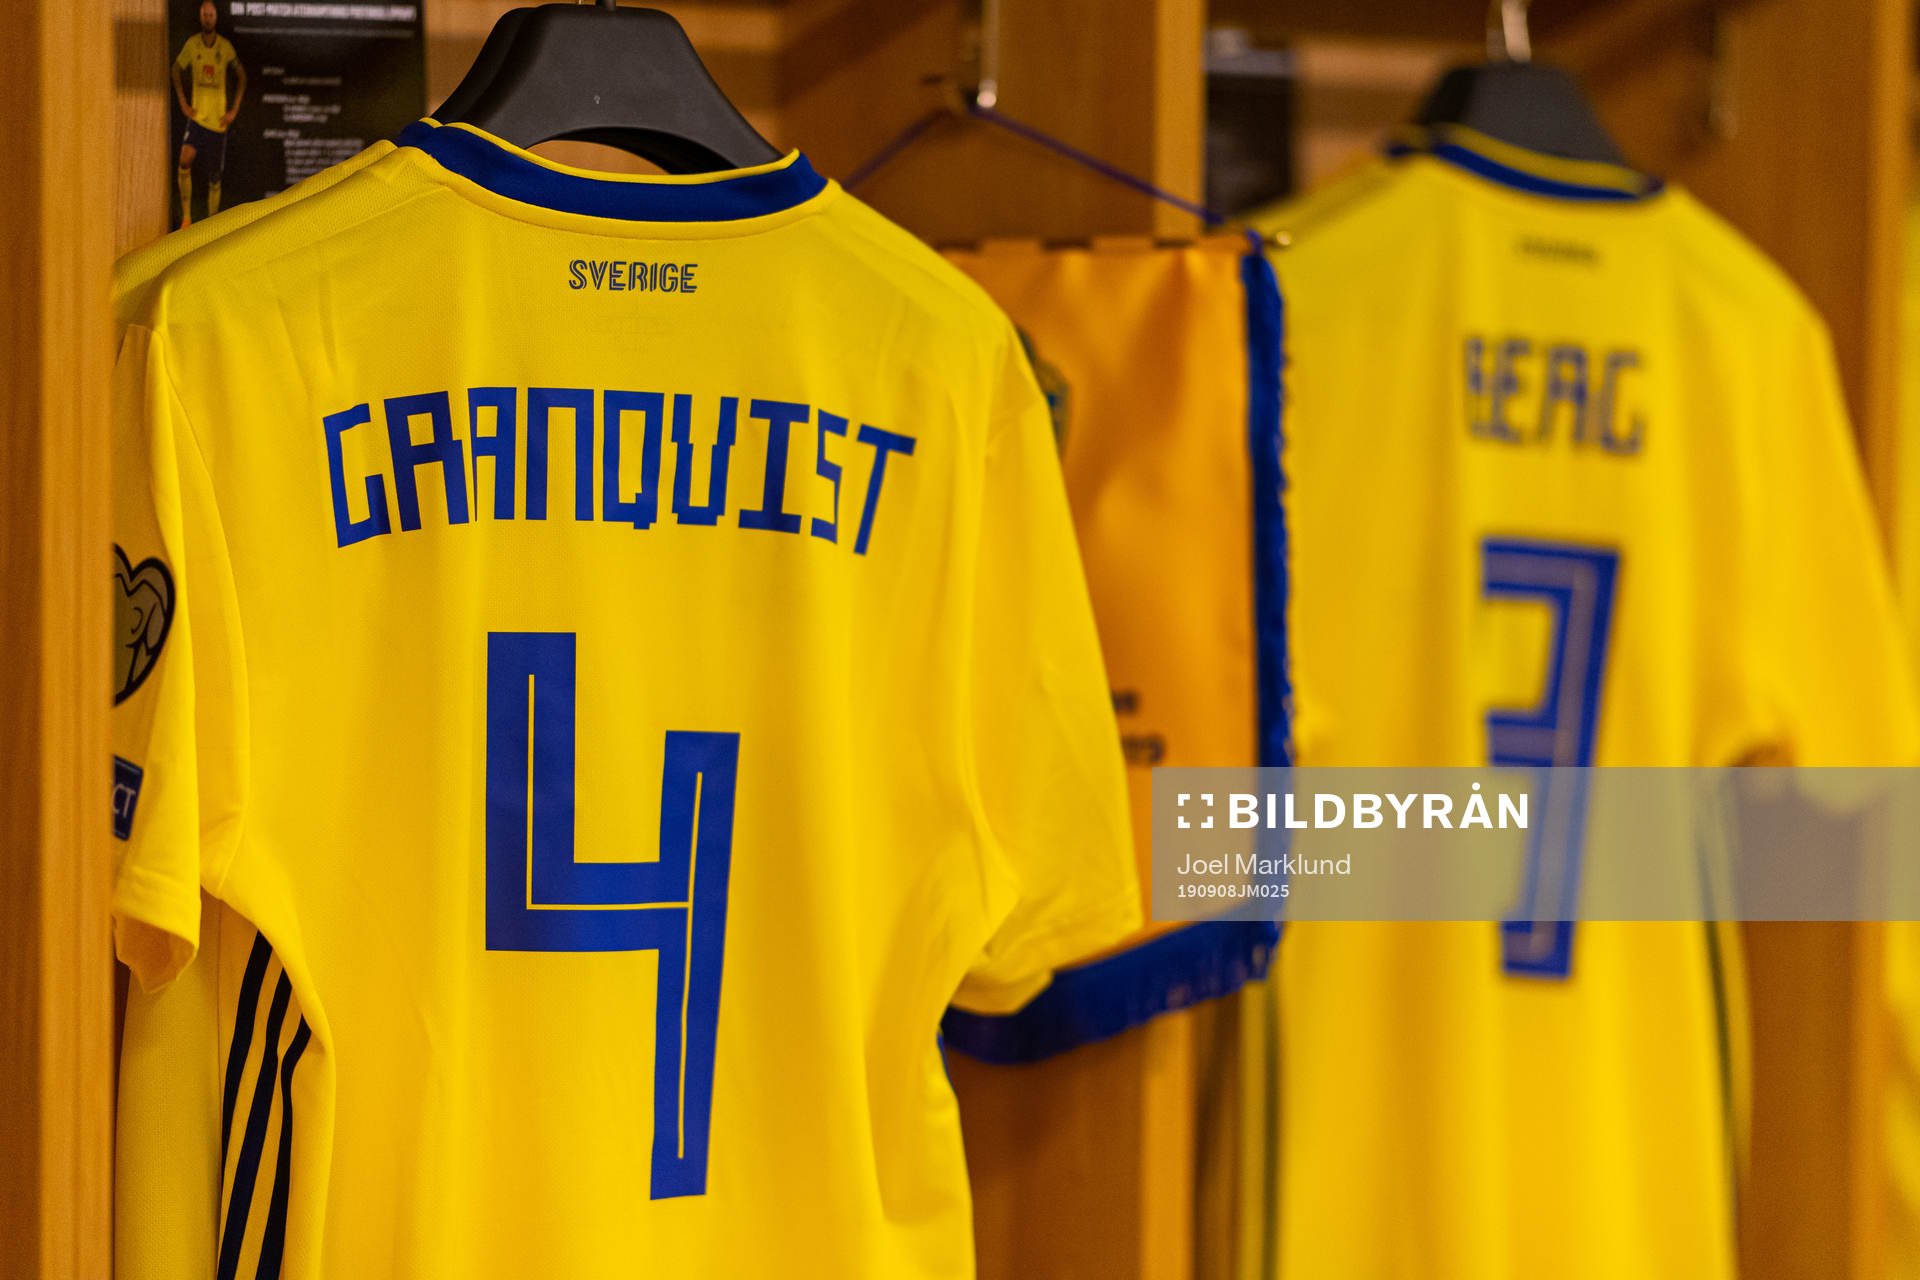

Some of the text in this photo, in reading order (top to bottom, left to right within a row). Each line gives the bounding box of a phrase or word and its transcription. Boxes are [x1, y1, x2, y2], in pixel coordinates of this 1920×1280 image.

[569, 259, 698, 293] SVERIGE
[322, 386, 917, 556] GRANQVIST
[1481, 535, 1620, 979] 3
[485, 631, 740, 1200] 4
